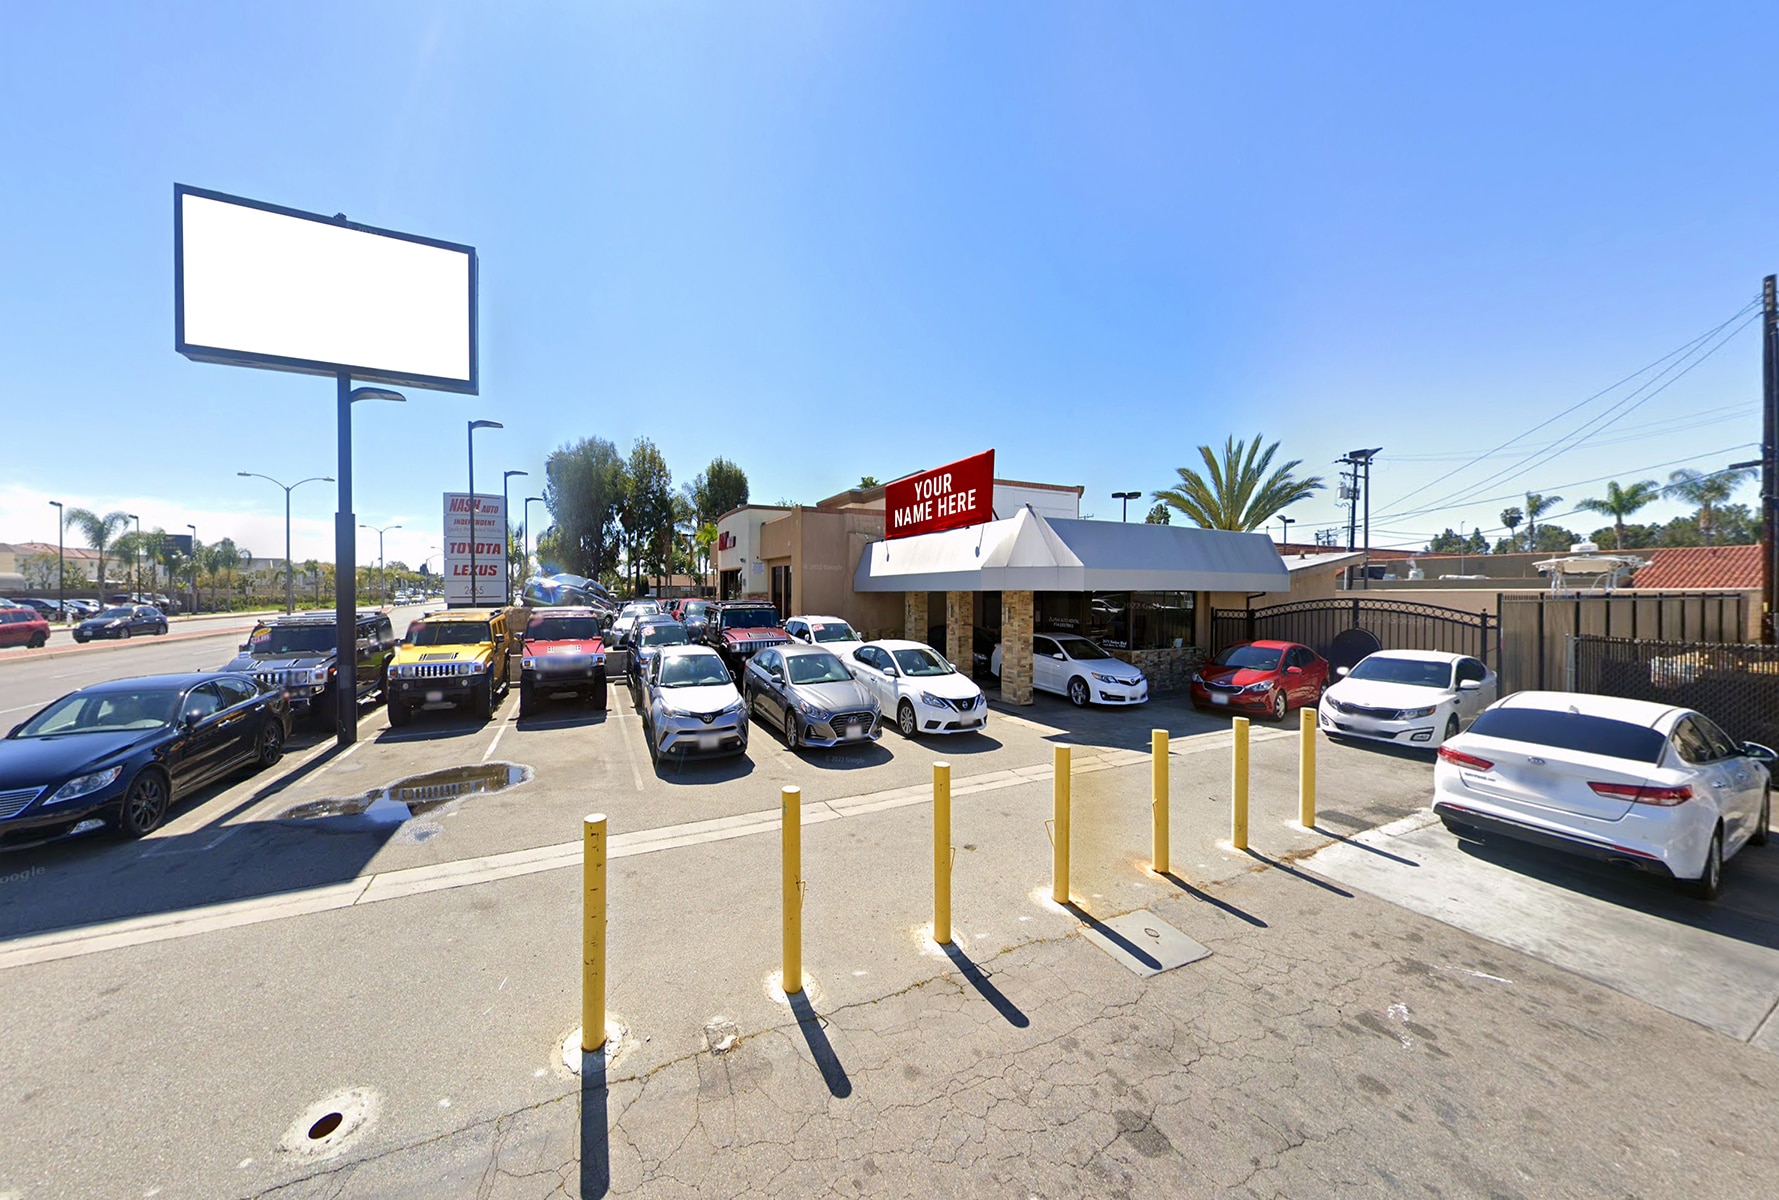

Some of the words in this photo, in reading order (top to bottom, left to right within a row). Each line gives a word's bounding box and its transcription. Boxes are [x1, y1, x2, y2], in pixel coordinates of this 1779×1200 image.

[914, 473, 952, 501] YOUR
[449, 498, 481, 512] NASH
[481, 505, 499, 514] AUTO
[894, 500, 933, 528] NAME
[937, 488, 977, 518] HERE
[453, 518, 496, 526] INDEPNDENT
[449, 542, 502, 555] TOYOTA
[453, 564, 498, 577] LEXUS
